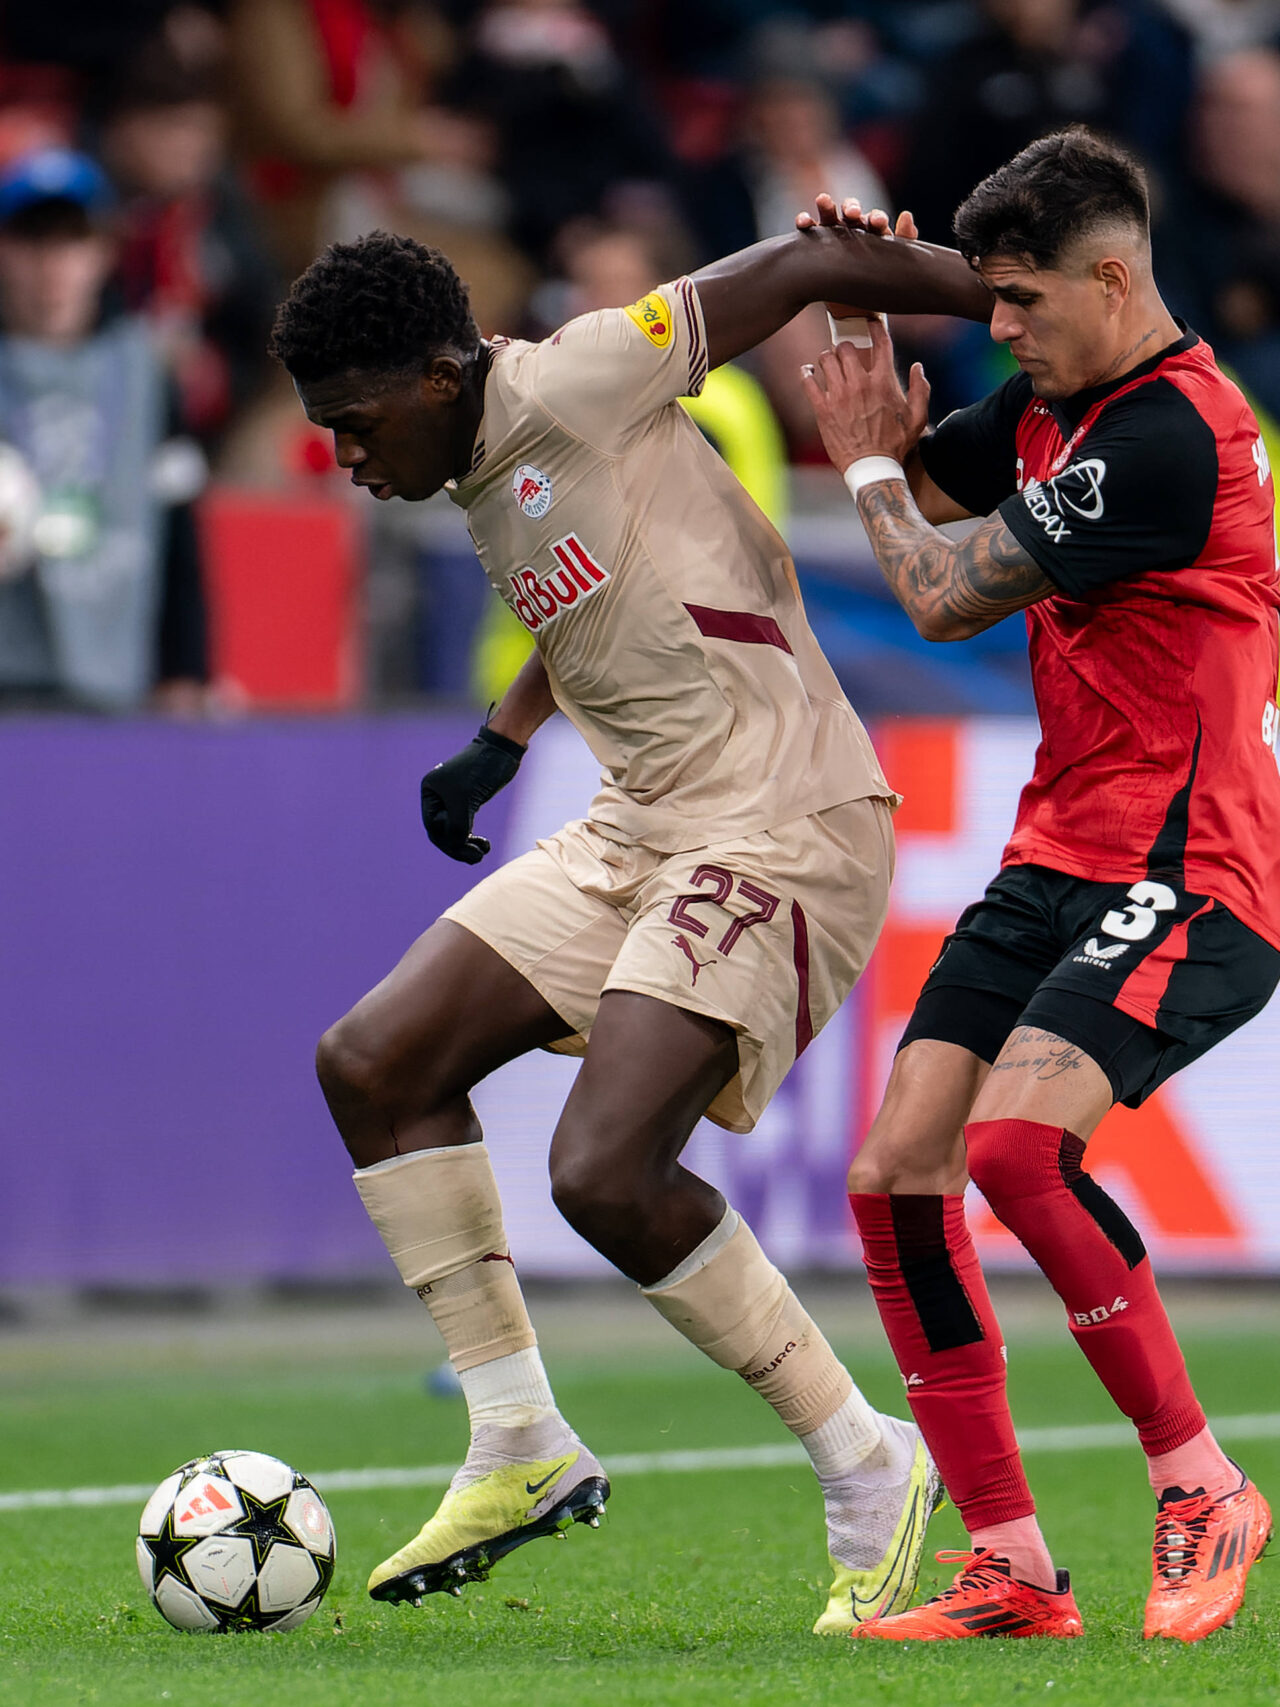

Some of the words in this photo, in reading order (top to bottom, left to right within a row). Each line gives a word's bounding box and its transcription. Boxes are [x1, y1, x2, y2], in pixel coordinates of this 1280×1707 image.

[1022, 476, 1073, 544] NIEDAX
[666, 863, 781, 957] 27
[1100, 880, 1177, 941] 3
